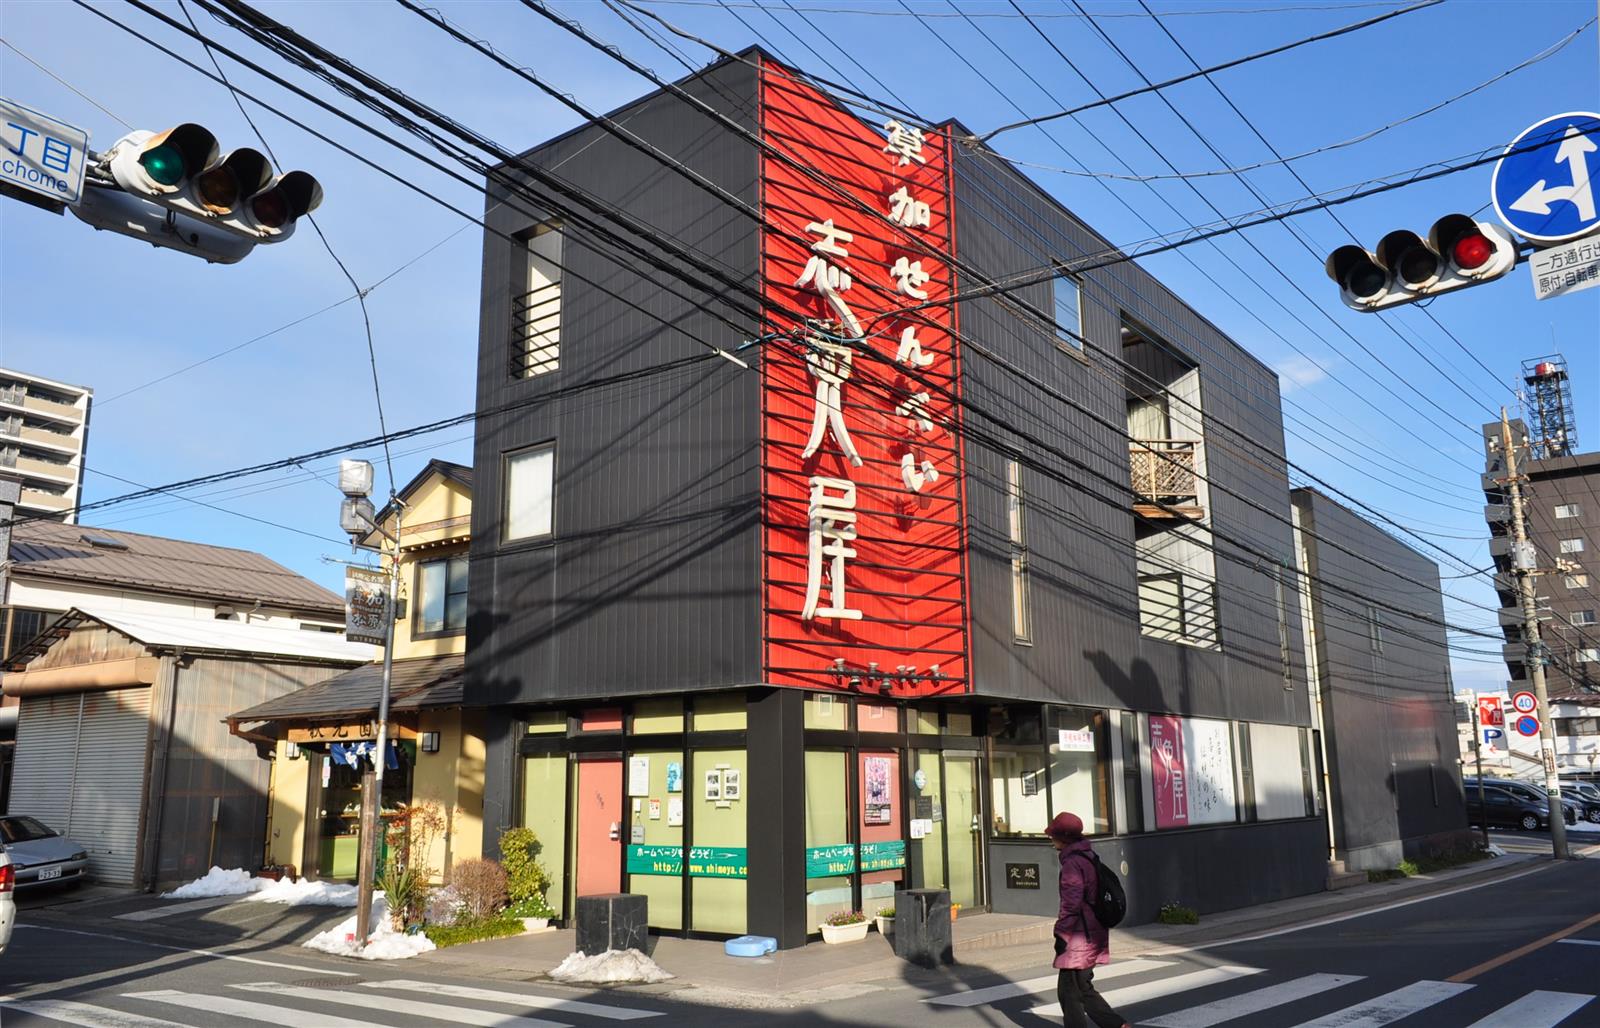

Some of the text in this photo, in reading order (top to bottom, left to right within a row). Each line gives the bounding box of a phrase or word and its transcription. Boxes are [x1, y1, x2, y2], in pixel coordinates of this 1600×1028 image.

[7, 122, 71, 173] 丁目
[0, 160, 68, 193] chome
[1518, 698, 1532, 708] 40
[1484, 729, 1502, 744] P
